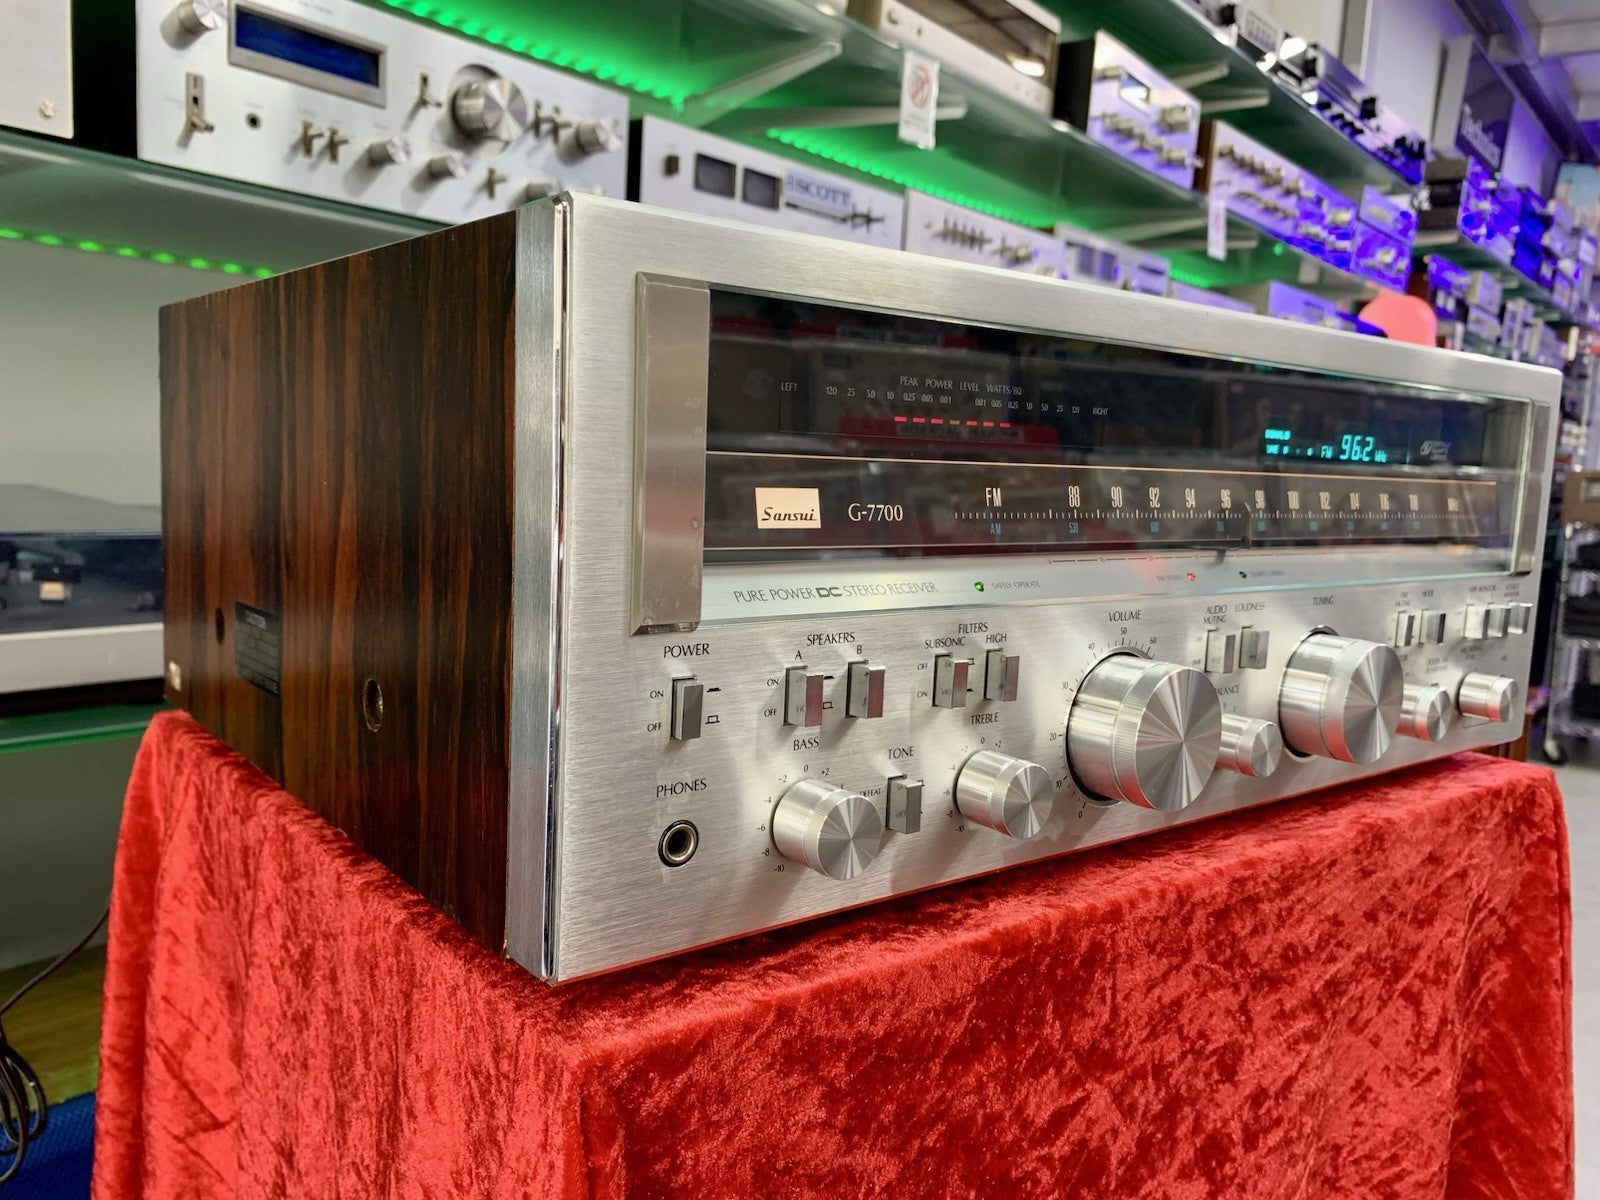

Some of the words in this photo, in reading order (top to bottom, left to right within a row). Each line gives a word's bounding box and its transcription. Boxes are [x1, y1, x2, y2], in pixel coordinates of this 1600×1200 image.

[781, 382, 798, 391] LEFT
[900, 376, 919, 387] PEAK
[925, 378, 954, 390] POWER
[959, 381, 980, 392] LEVEL
[985, 487, 1002, 507] FM
[1068, 486, 1080, 508] 88
[1111, 486, 1123, 508] 90
[1149, 487, 1161, 509] 92
[1185, 488, 1196, 509] 94
[1220, 488, 1231, 509] 96
[761, 507, 817, 522] Sansui
[848, 503, 903, 522] G-7700
[990, 522, 1002, 535] AM
[991, 581, 1012, 590] SAFELY
[1013, 580, 1042, 589] OPERATE
[733, 588, 768, 603] PURE
[769, 586, 817, 602] POWER
[816, 586, 843, 598] DC
[843, 583, 888, 598] STEREO
[887, 581, 939, 595] RECEIVER
[1312, 596, 1334, 606] TUNING
[1205, 605, 1227, 615] AUDIO
[1234, 602, 1265, 613] LOUDNESS
[1108, 610, 1142, 622] VOLUME
[958, 622, 988, 634] FILTERS
[1120, 627, 1127, 635] 50
[807, 632, 856, 647] SPEAKERS
[925, 636, 966, 649] SUBSONIC
[985, 633, 1007, 643] HIGH
[1149, 636, 1158, 645] 60
[663, 643, 710, 658] POWER
[795, 650, 803, 660] A
[856, 645, 863, 655] B
[767, 678, 779, 687] ON
[1062, 682, 1069, 691] 30
[650, 690, 664, 699] ON
[917, 691, 928, 699] ON
[1216, 685, 1240, 696] ALANCE
[764, 708, 778, 717] OFF
[971, 712, 999, 725] TREBLE
[647, 723, 663, 732] OFF
[1049, 733, 1057, 742] 20
[792, 738, 819, 751] BASS
[888, 746, 914, 760] TONE
[804, 764, 809, 772] 0
[778, 775, 787, 783] -2
[656, 778, 707, 798] PHONES
[943, 788, 951, 796] -6
[1078, 811, 1083, 819] 0
[757, 823, 766, 832] -6
[761, 848, 770, 856] -8
[773, 864, 785, 873] -10
